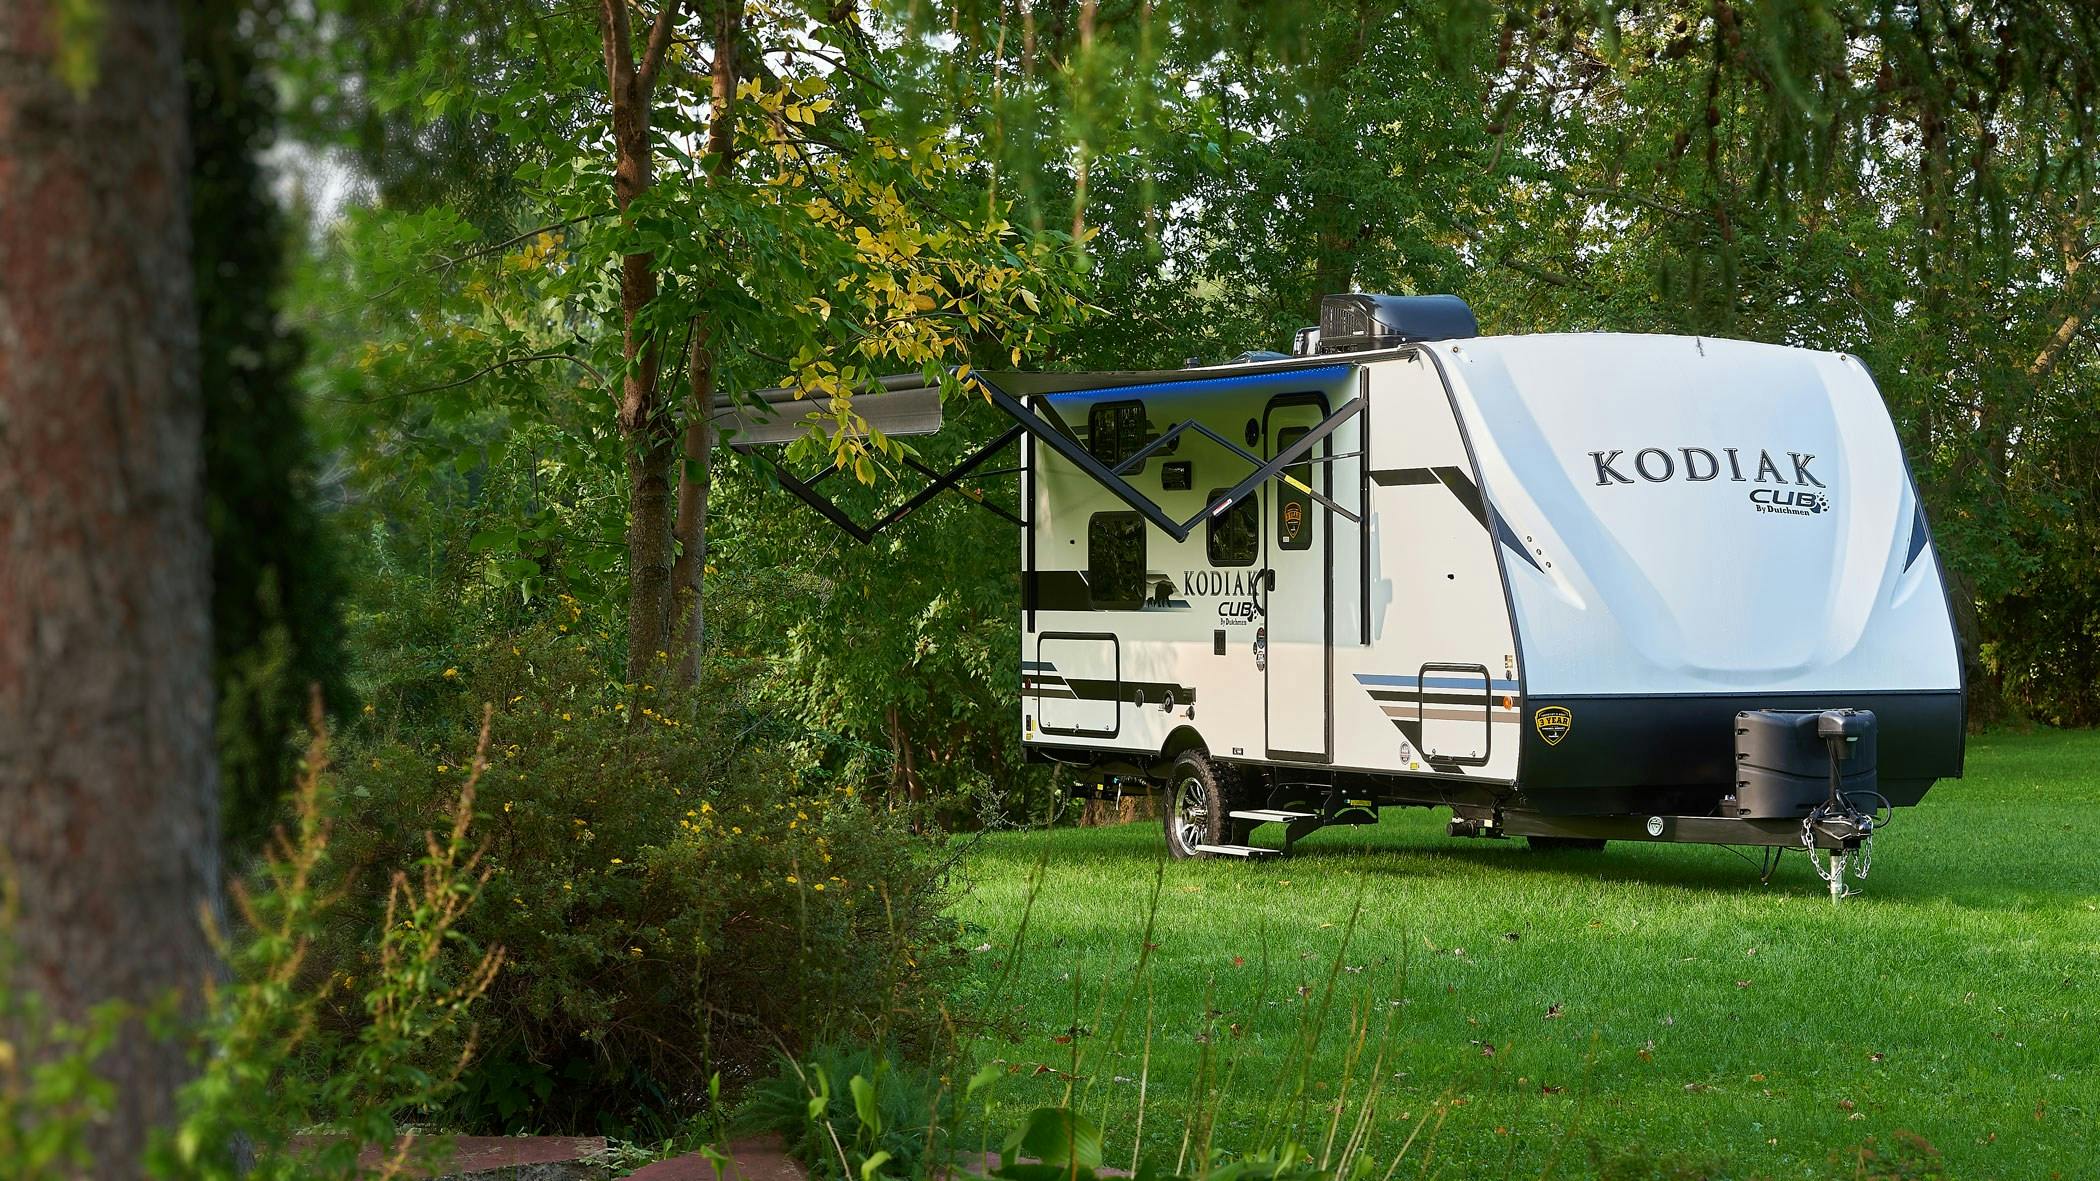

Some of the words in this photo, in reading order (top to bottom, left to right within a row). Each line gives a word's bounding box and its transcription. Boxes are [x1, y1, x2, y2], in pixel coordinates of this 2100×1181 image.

[1588, 447, 1826, 488] KODIAK
[1750, 489, 1816, 507] CUB
[1756, 505, 1766, 514] By
[1767, 505, 1810, 516] Dutchmen
[1184, 570, 1259, 596] KODIAK
[1218, 602, 1252, 616] CUB
[1546, 717, 1568, 726] YEAR
